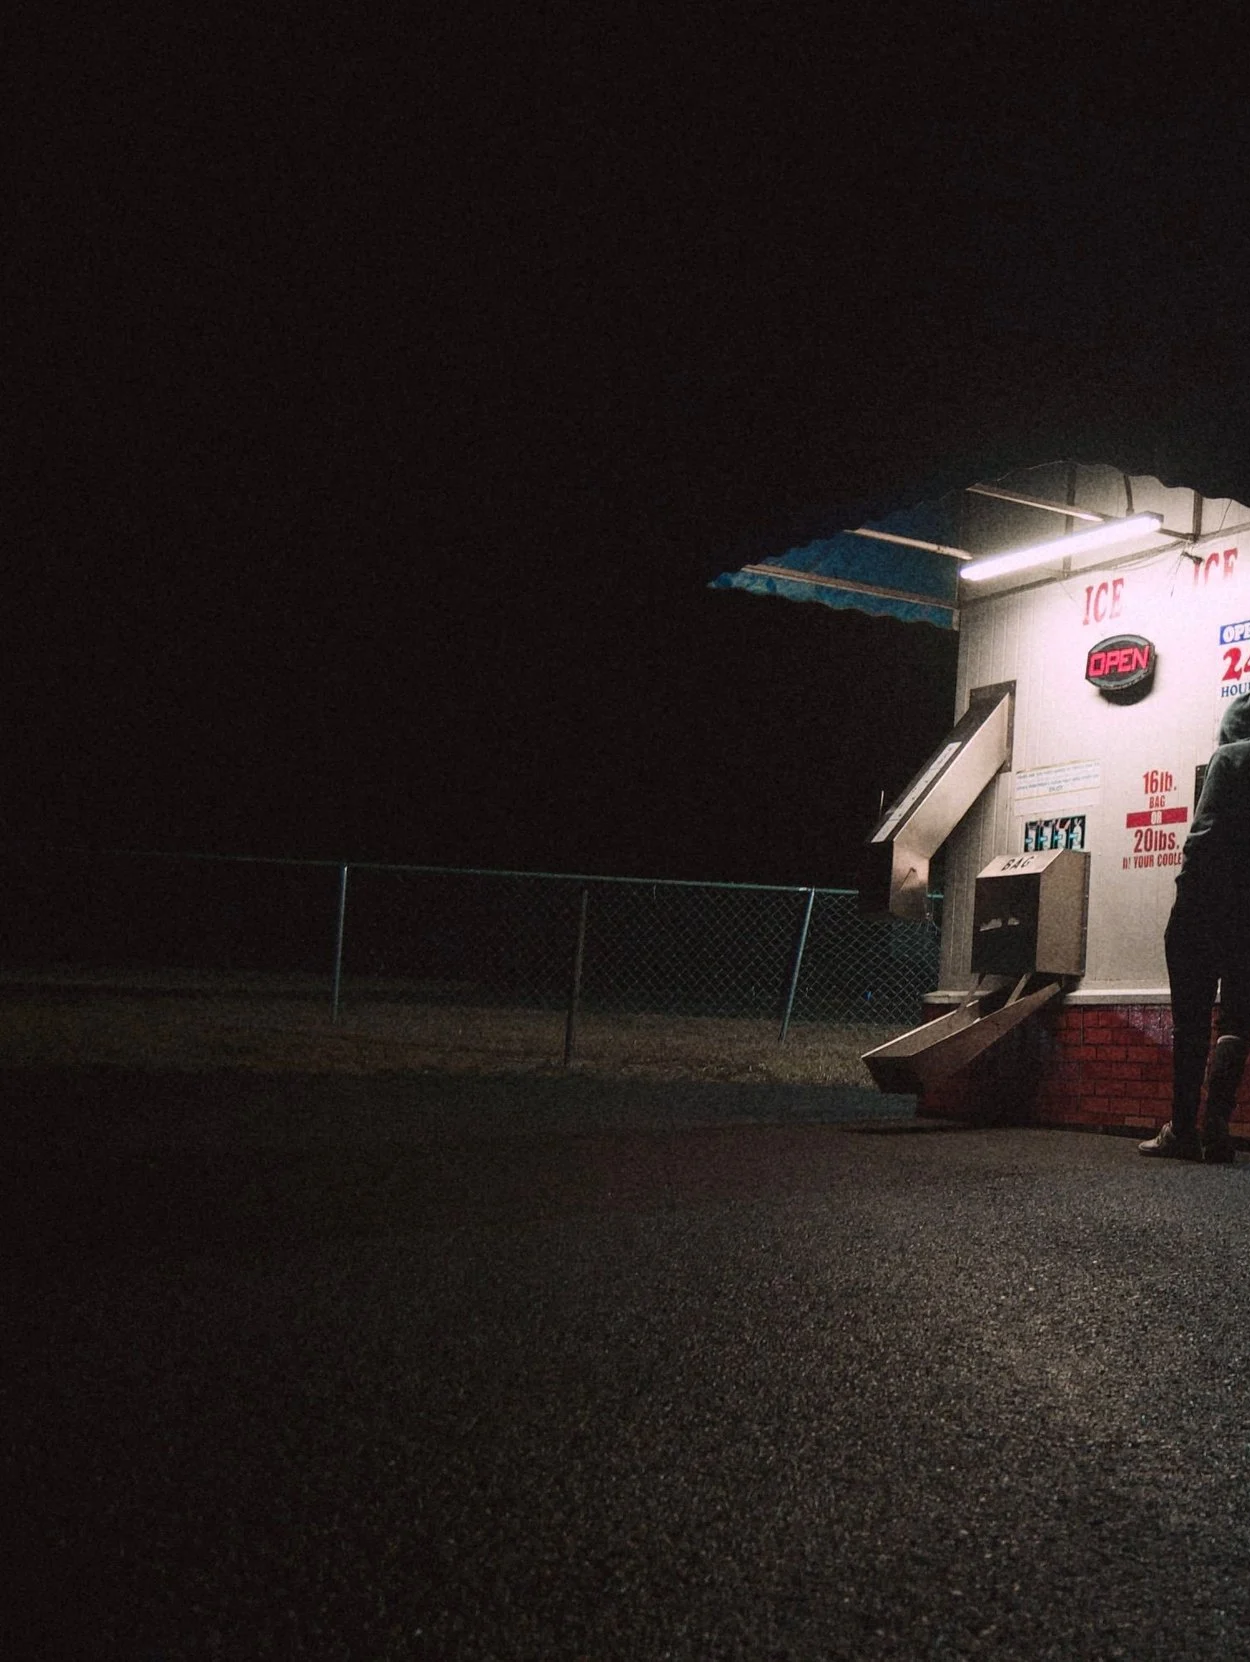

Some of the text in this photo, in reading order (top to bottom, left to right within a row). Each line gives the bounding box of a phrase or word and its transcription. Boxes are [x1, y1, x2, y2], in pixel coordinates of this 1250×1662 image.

[1082, 577, 1124, 626] ICE
[1088, 645, 1150, 677] OPEN
[1142, 769, 1177, 794] 16lb.
[1149, 795, 1166, 809] BAG
[1150, 811, 1163, 825] OR
[1133, 828, 1180, 853] 20lbs.
[1001, 856, 1035, 872] BAG
[1133, 854, 1155, 869] YOUR
[1157, 852, 1183, 867] COOLE
